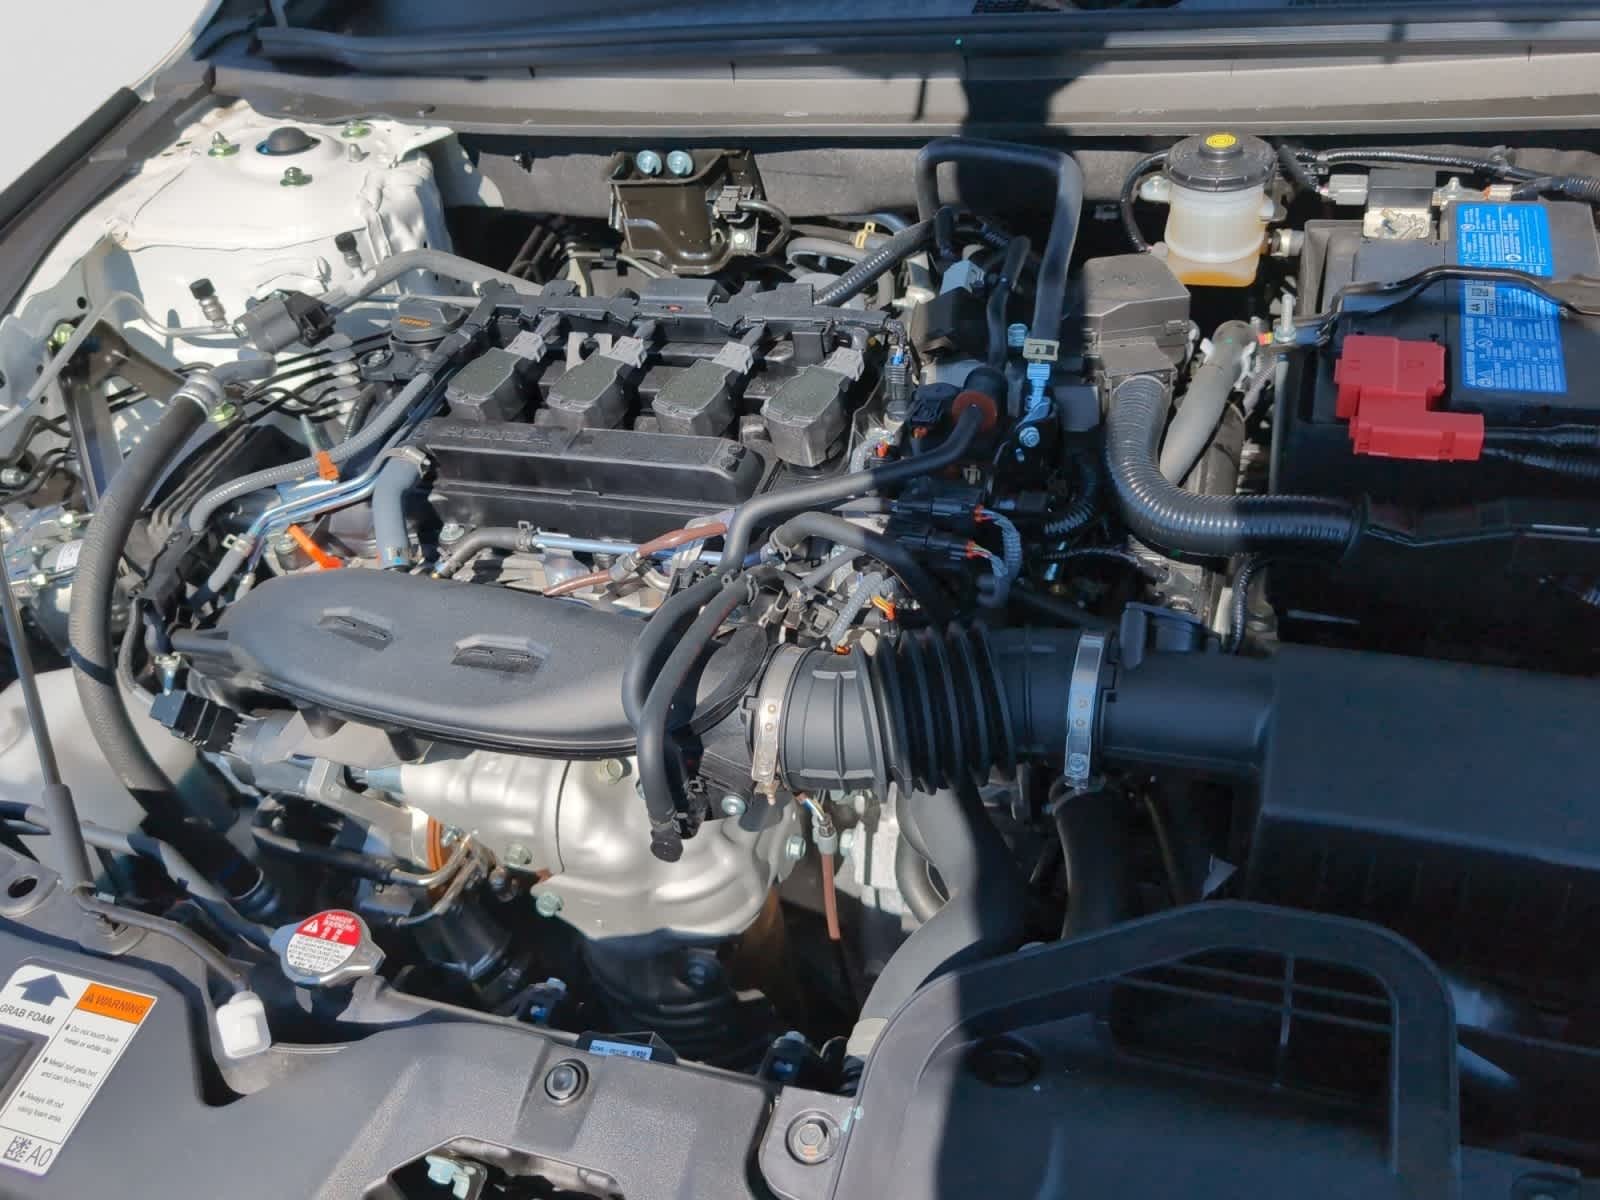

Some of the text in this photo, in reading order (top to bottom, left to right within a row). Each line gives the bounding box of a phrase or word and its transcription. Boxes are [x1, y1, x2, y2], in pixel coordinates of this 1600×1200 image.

[0, 1003, 55, 1025] GRAB FOAM
[95, 995, 146, 1015] WARNING
